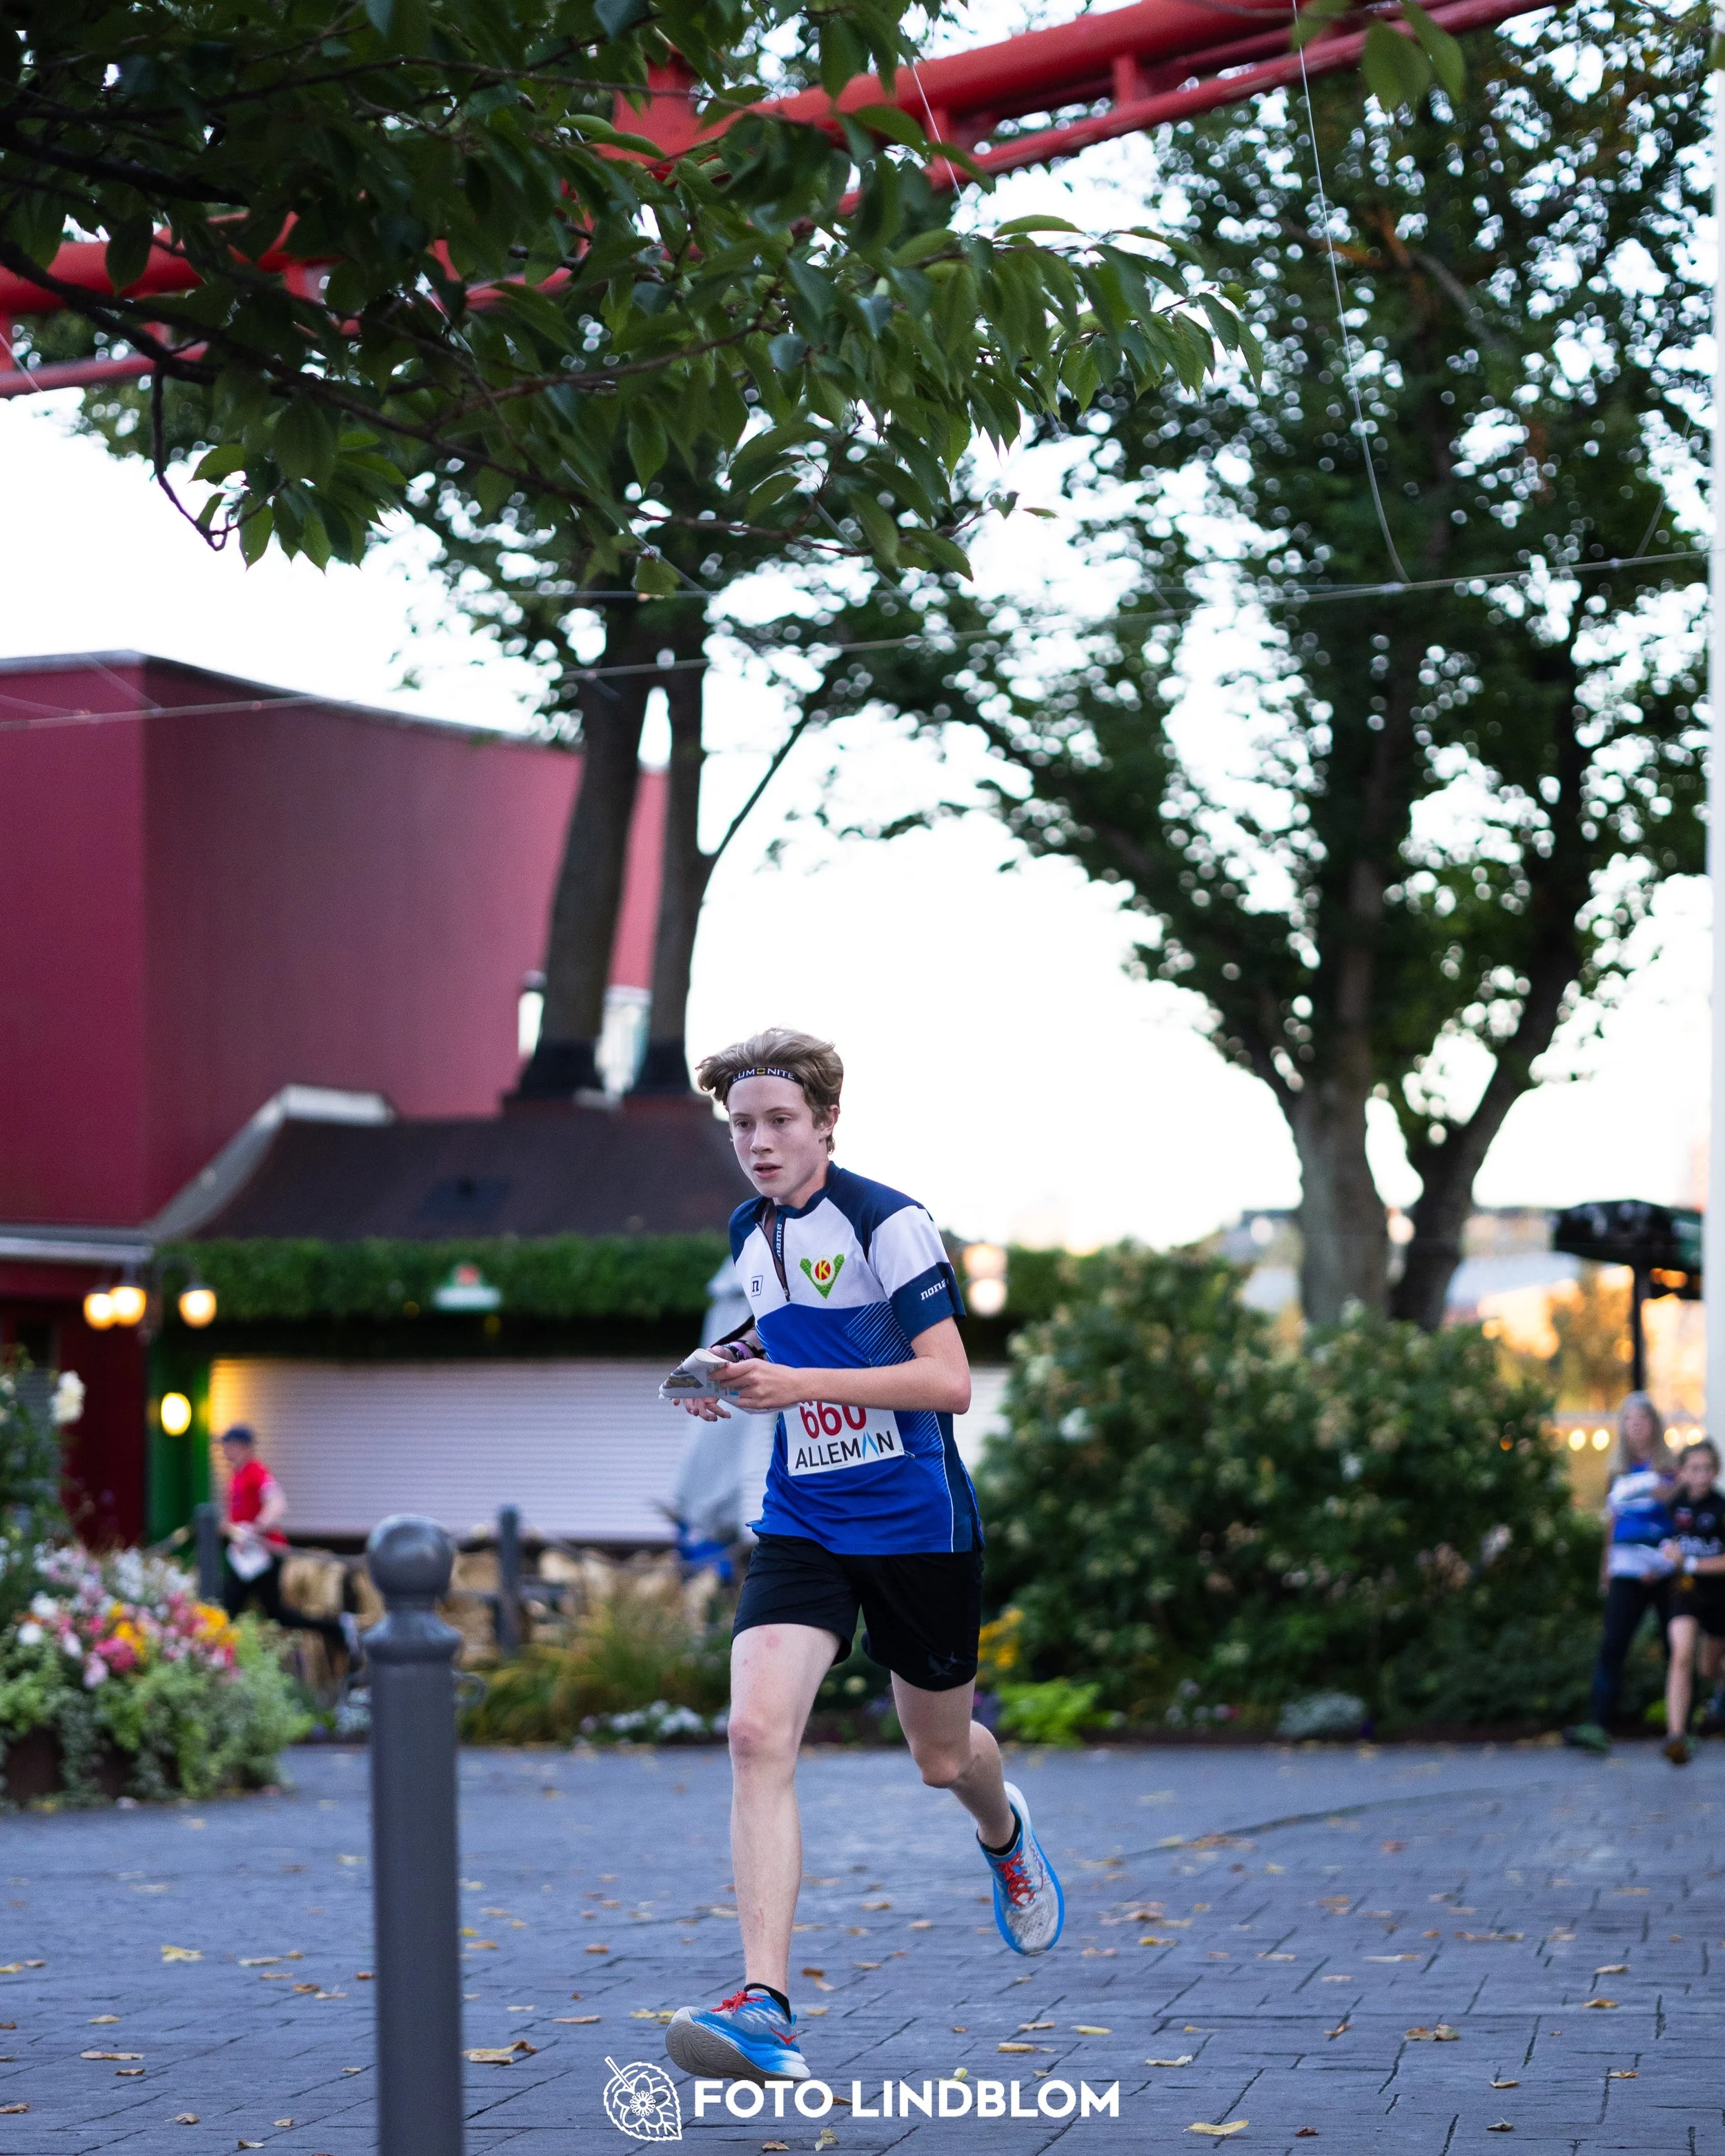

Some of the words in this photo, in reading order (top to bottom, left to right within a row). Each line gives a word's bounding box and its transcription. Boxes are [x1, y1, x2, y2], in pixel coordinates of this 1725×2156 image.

[733, 1067, 795, 1082] LUMONITE
[920, 1278, 949, 1300] nona
[795, 1430, 895, 1469] ALLEMAN
